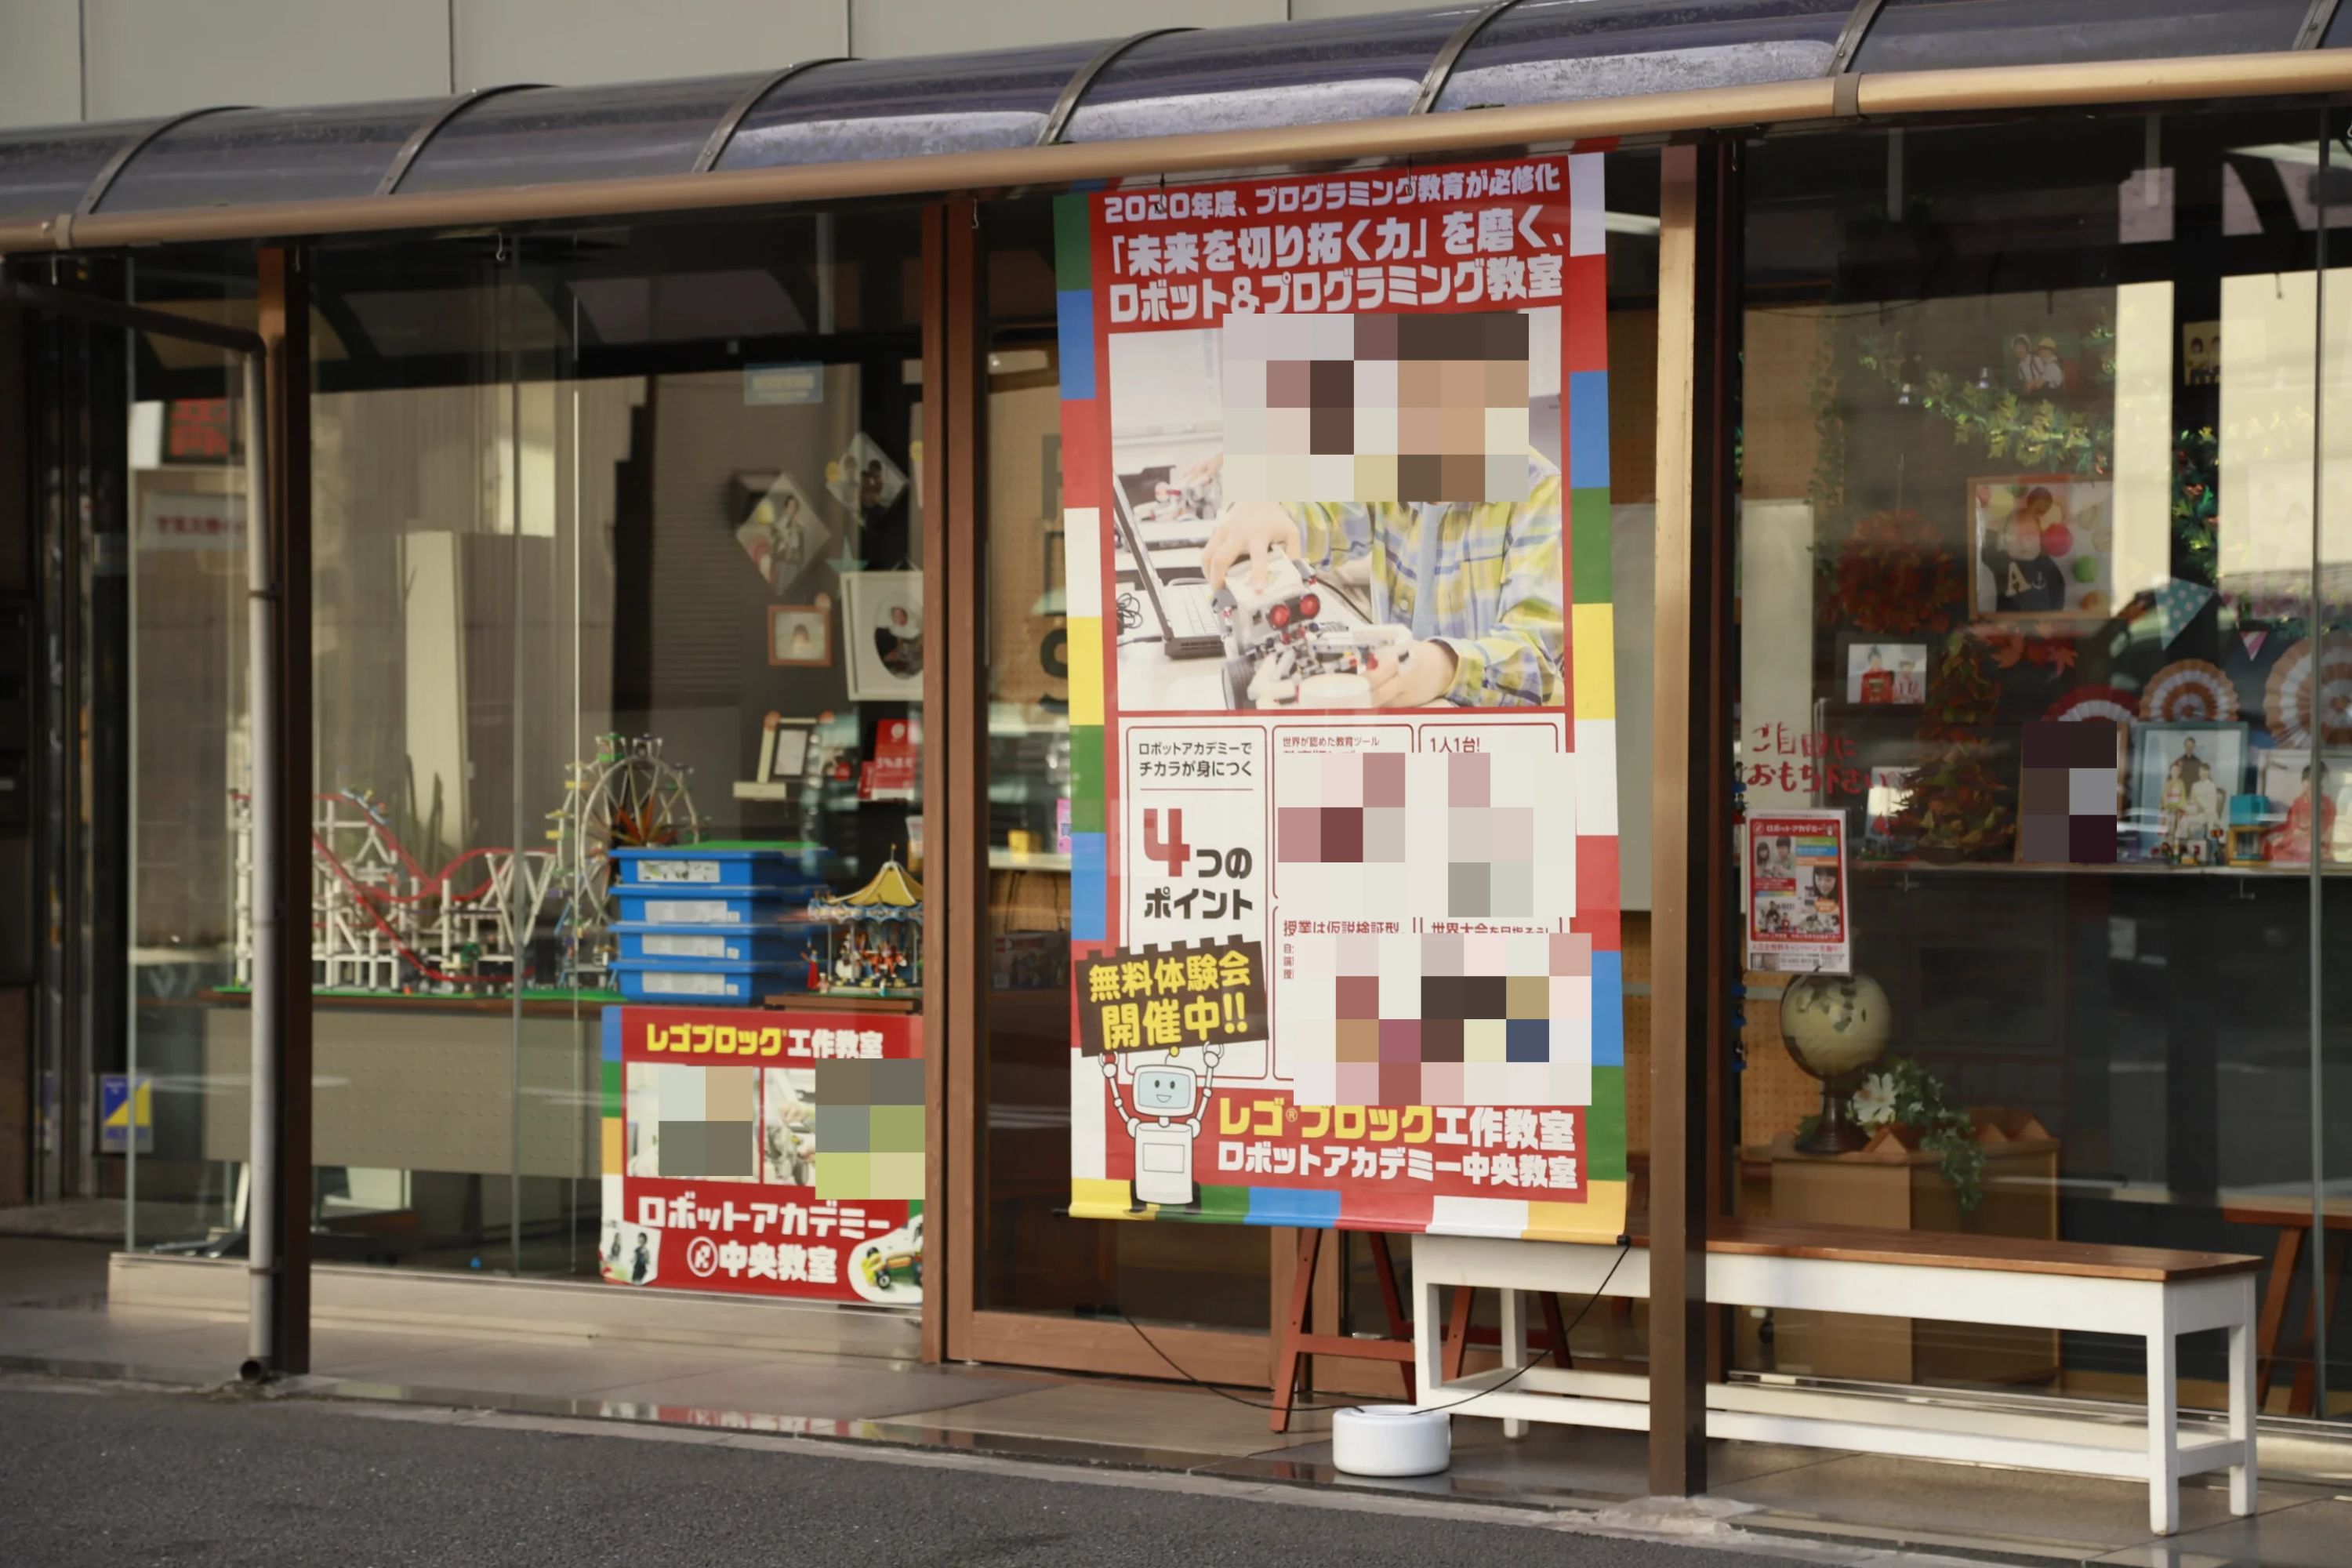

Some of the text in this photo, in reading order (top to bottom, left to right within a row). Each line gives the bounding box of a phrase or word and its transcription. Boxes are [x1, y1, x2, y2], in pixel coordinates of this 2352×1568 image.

[1104, 163, 1561, 223] 2020年度、プログラミング教育が必修化
[1112, 205, 1564, 277] 「未来を切り拓く力」を磨く、
[1109, 253, 1563, 323] ロボット&プログラミング教室
[1138, 742, 1253, 756] ロボットアカデミーで
[1282, 735, 1380, 748] 世界が認めた教育ツール
[1429, 735, 1481, 753] 1人1台!
[1139, 760, 1253, 778] チカラが身につく
[1143, 808, 1253, 880] 4つの
[1144, 886, 1253, 920] ポイント
[1089, 949, 1251, 1003] 無料体験会
[1101, 992, 1248, 1051] 開催中!!
[1218, 1140, 1578, 1189] ロボットアカデミー中央教室
[637, 1191, 891, 1240] ロボットアカデミー
[718, 1240, 838, 1284] 中央教室
